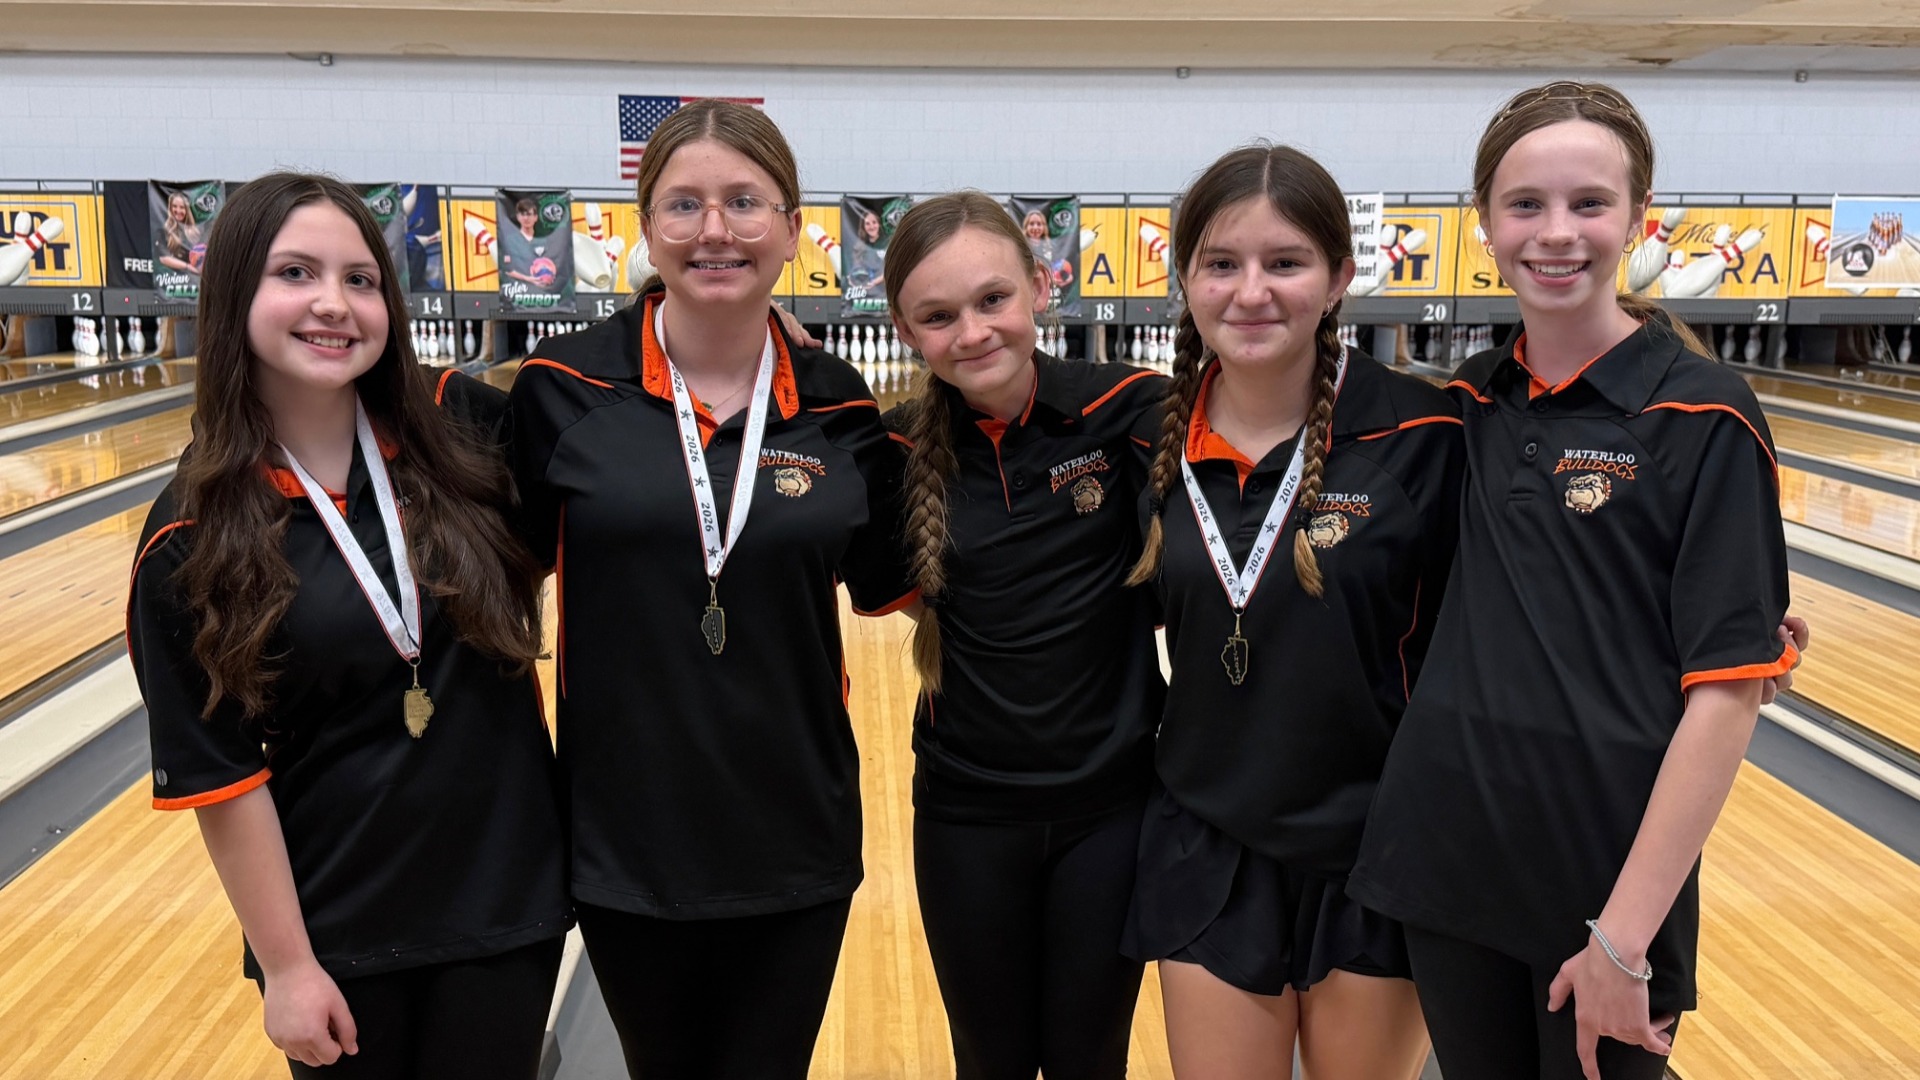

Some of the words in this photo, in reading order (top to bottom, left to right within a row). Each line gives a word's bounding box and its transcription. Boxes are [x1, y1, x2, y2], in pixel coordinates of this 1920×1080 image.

[156, 271, 190, 287] Vivian
[502, 280, 529, 299] Tyler
[72, 292, 94, 312] 12
[421, 297, 443, 315] 14
[513, 293, 561, 307] POIROT
[595, 299, 615, 318] 15
[1094, 303, 1115, 320] 18
[1422, 303, 1447, 322] 20
[1757, 304, 1779, 322] 22
[685, 434, 699, 464] 2026
[761, 448, 821, 465] WATERLOO
[1564, 449, 1635, 464] WATERLOO
[758, 456, 826, 476] BULLDOGS
[1049, 449, 1103, 477] WATERLOO
[1553, 458, 1638, 481] BULLDOGS
[1050, 456, 1111, 494] BULLDOGS
[1278, 473, 1298, 505] 2026
[700, 502, 715, 532] 2026
[1194, 495, 1210, 524] 2026
[1247, 545, 1265, 575] 2026
[1217, 556, 1236, 586] 2026
